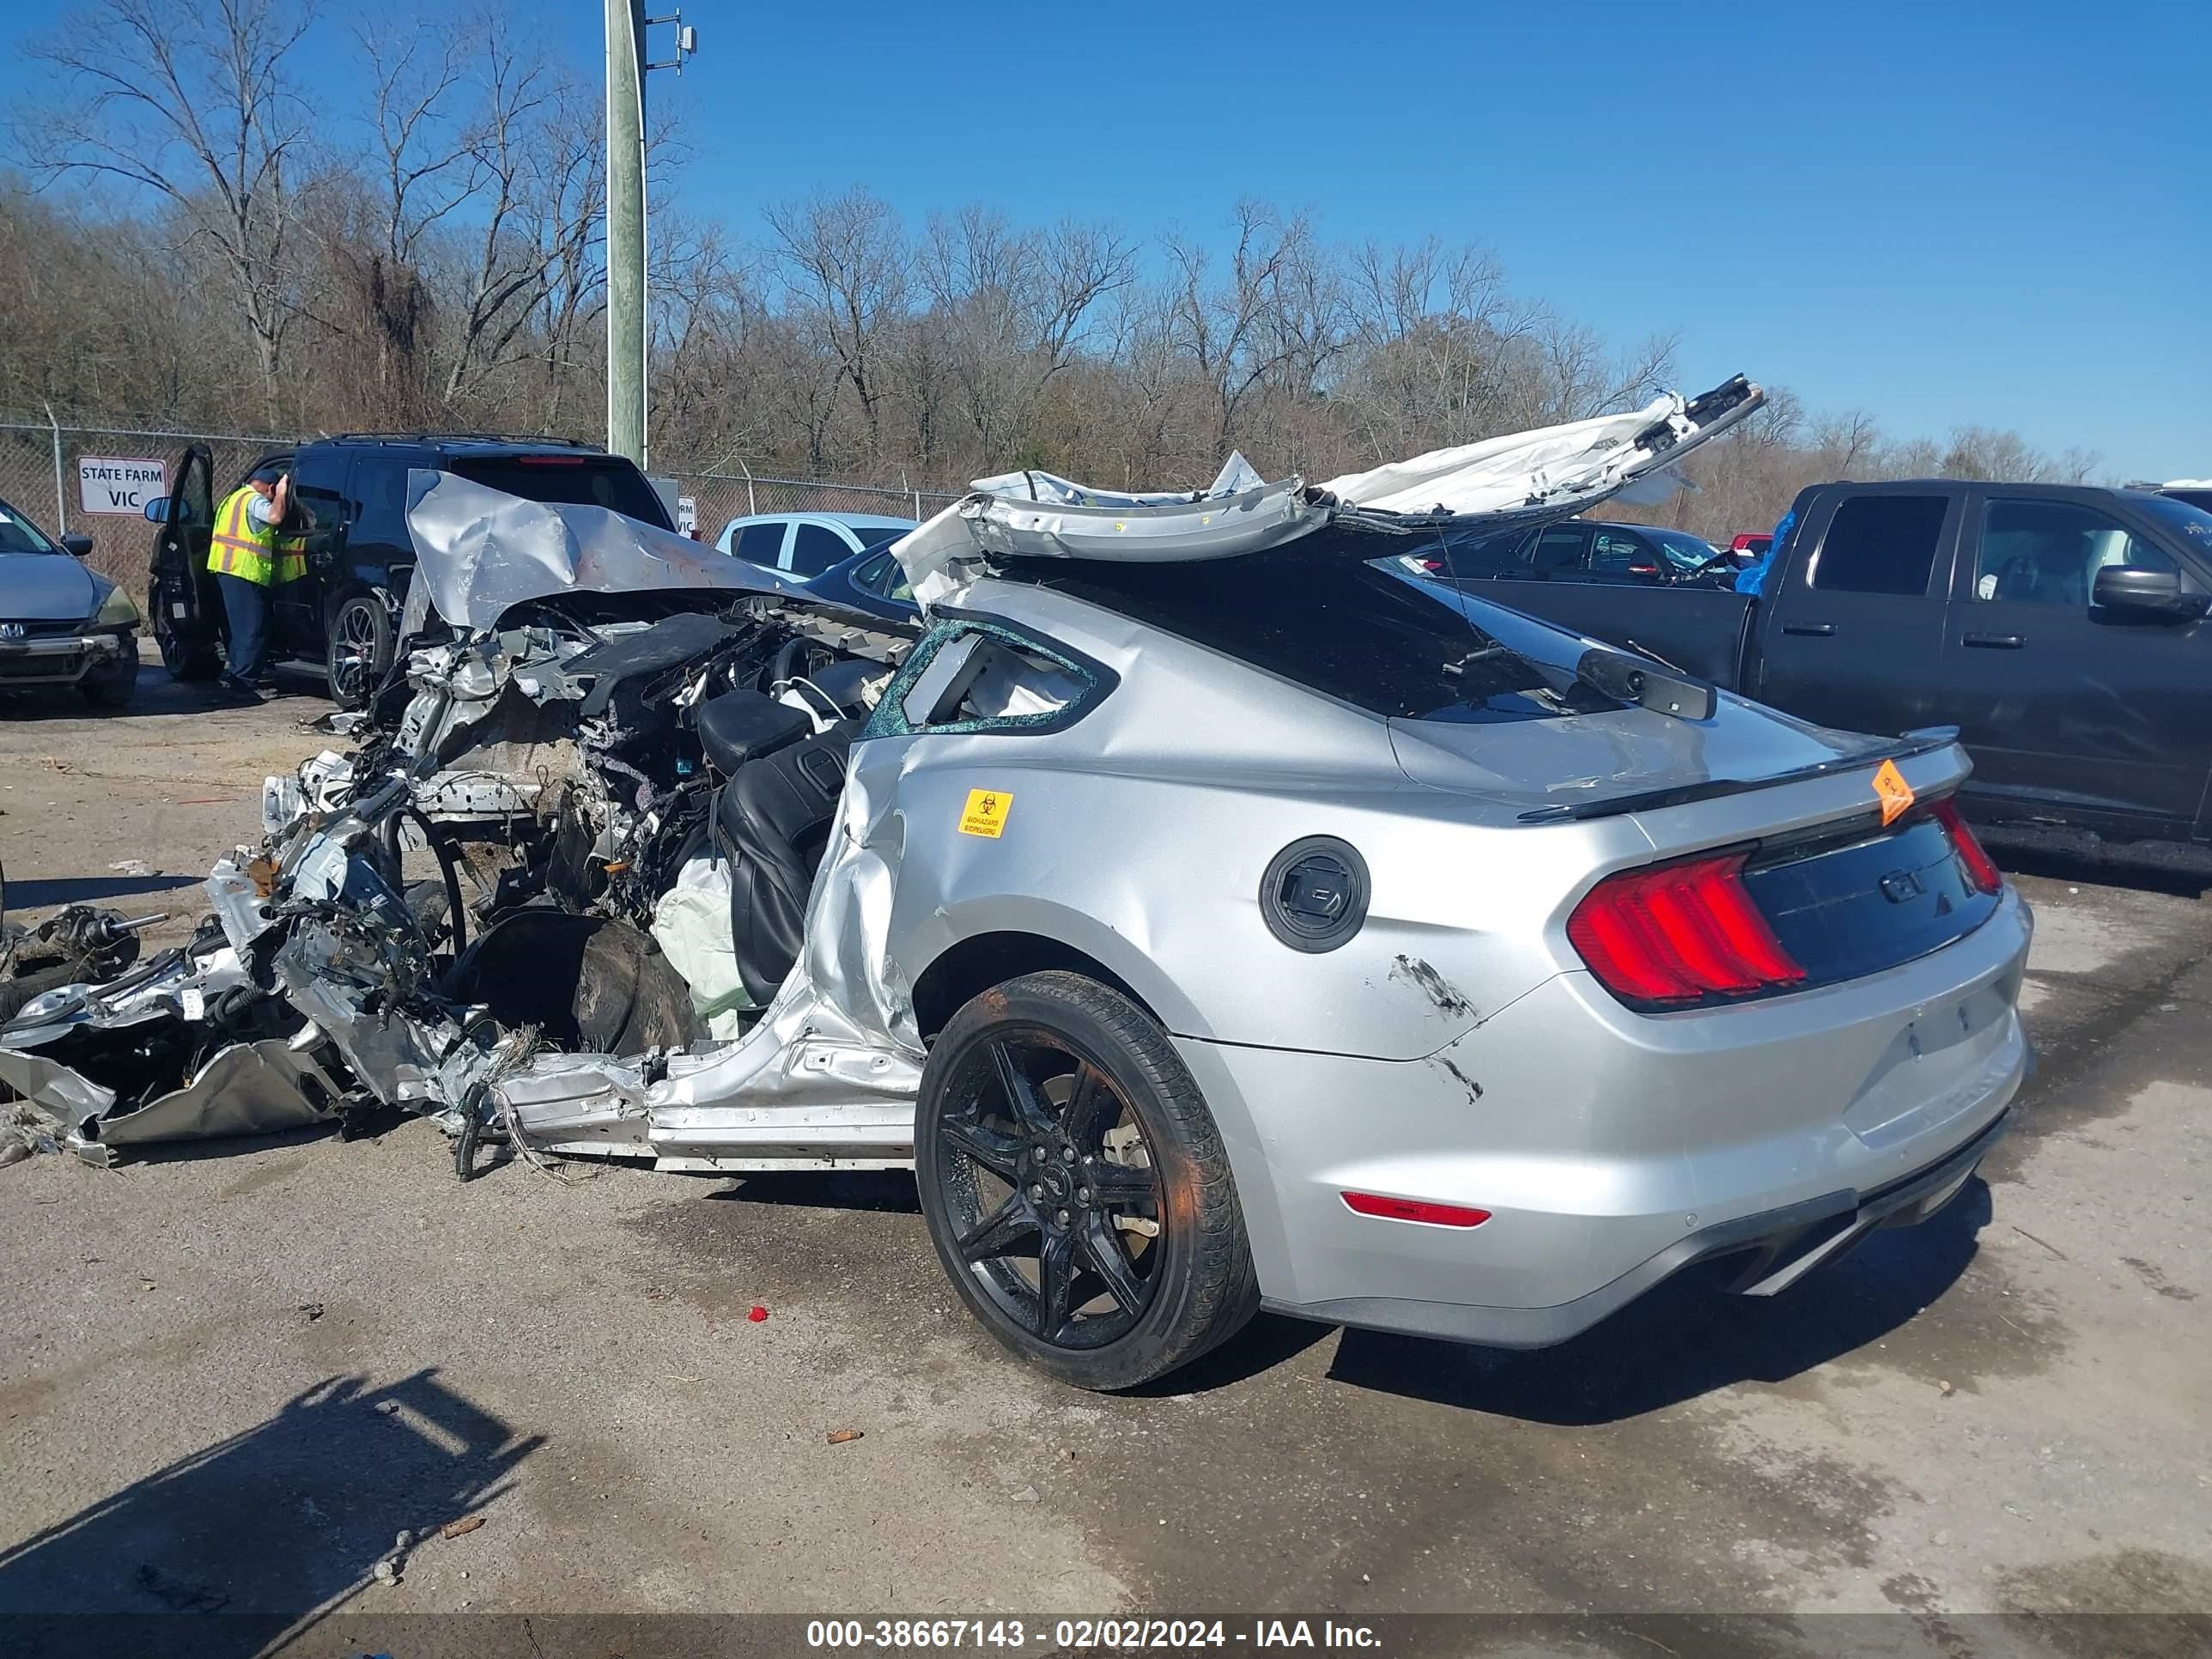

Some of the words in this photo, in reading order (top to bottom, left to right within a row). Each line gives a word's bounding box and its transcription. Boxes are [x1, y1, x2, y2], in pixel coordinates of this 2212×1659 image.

[82, 467, 122, 481] STATE
[125, 470, 162, 483] FARM
[109, 490, 139, 507] VIC
[678, 505, 693, 514] RM
[967, 816, 999, 827] BIOHAZARD
[963, 824, 996, 836] BIOPELIGRO
